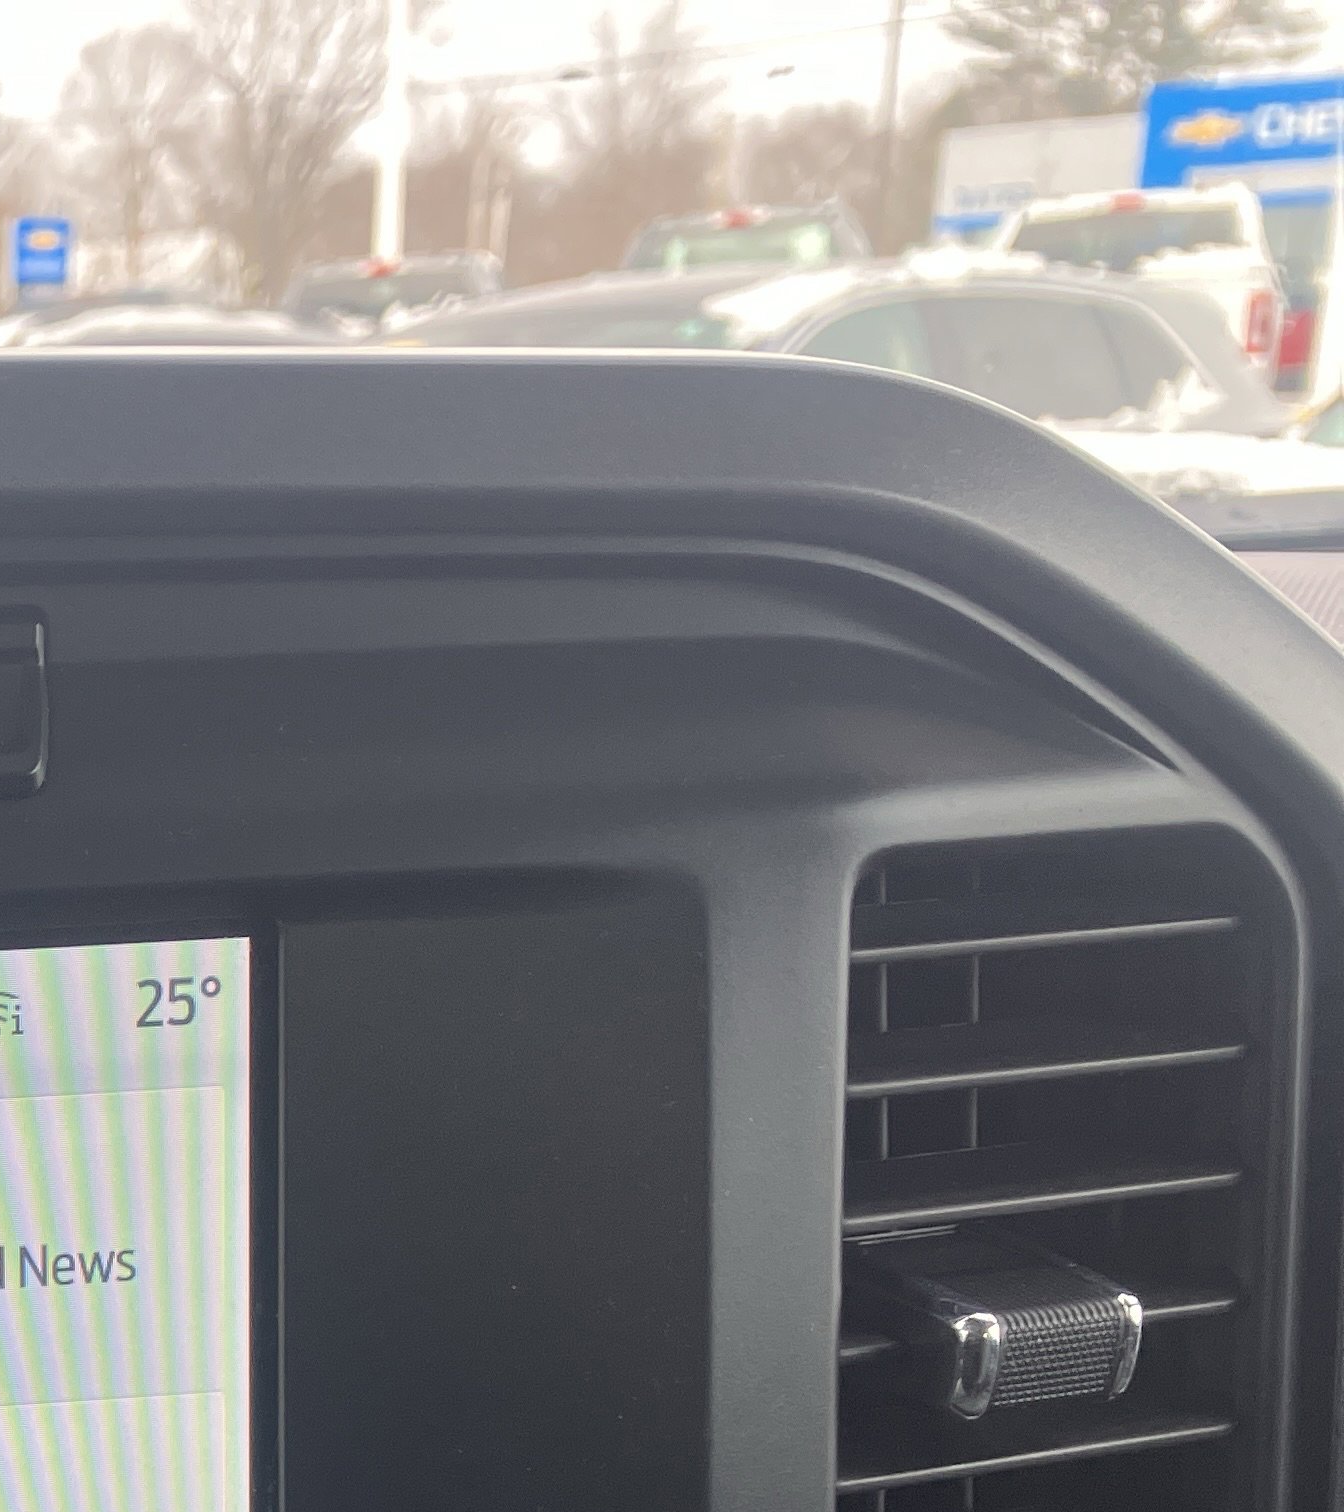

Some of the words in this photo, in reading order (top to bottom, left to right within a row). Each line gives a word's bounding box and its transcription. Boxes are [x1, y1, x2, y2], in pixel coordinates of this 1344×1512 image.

[1252, 100, 1344, 150] CHE
[136, 976, 222, 1029] 25°
[18, 1243, 138, 1290] News
